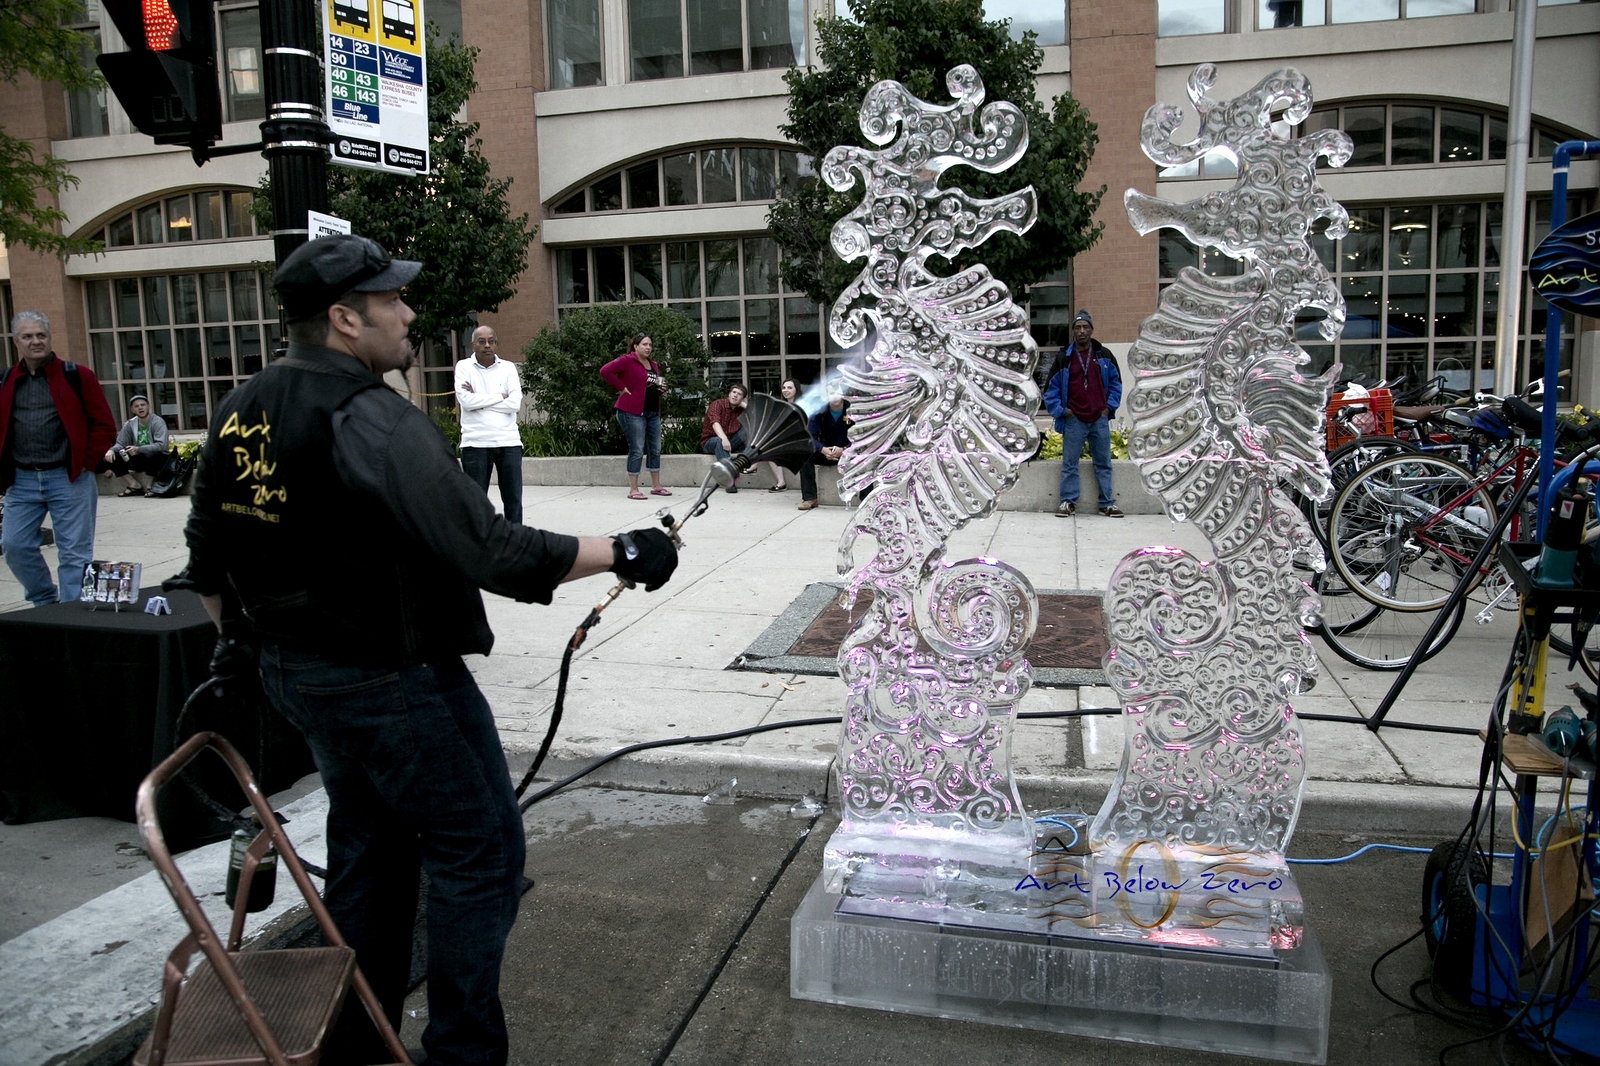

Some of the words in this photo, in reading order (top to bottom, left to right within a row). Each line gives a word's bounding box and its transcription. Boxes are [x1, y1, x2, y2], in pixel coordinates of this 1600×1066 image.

[330, 36, 344, 49] 14
[354, 42, 370, 55] 23
[332, 53, 347, 66] 90
[332, 68, 348, 81] 40
[356, 74, 371, 87] 43
[381, 79, 404, 89] WAUKESHA
[405, 84, 423, 93] COUNTY
[332, 86, 348, 98] 46
[357, 90, 377, 103] 143
[381, 85, 400, 94] EXPRESS
[344, 102, 361, 113] Blue
[352, 111, 369, 121] Line
[1538, 267, 1598, 289] Art
[219, 410, 271, 443] Art
[1014, 873, 1091, 894] Art
[1103, 865, 1189, 899] Below
[1200, 872, 1283, 893] Zero
